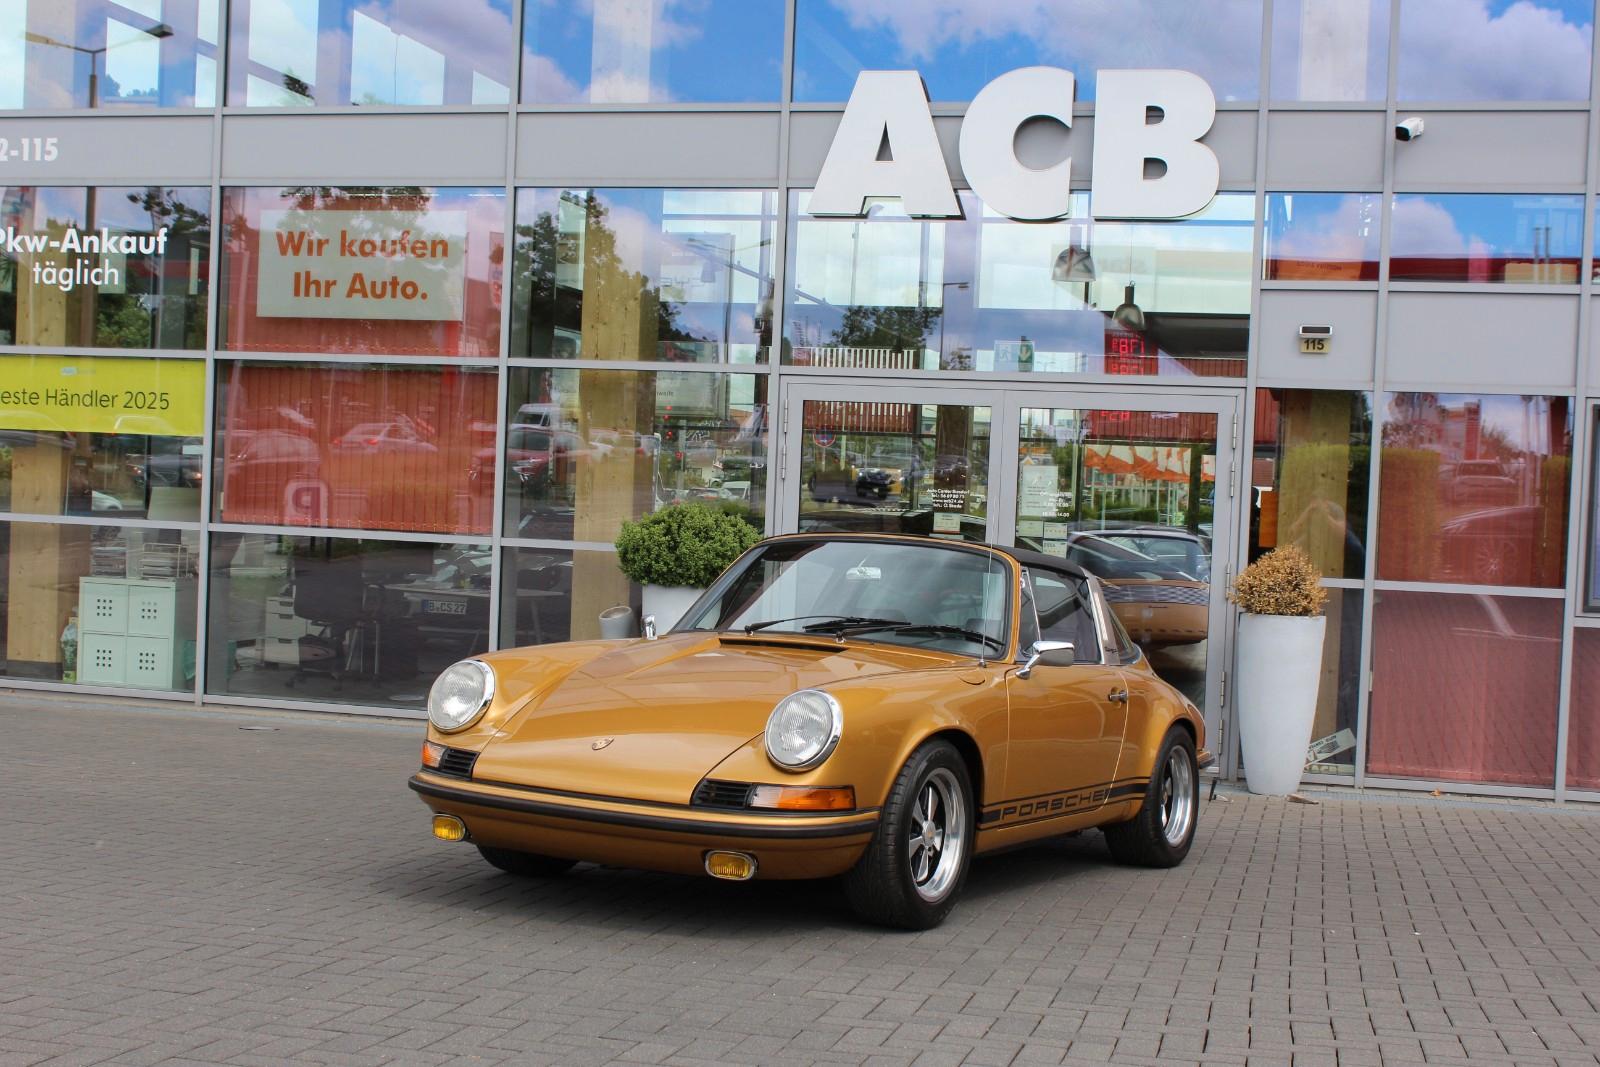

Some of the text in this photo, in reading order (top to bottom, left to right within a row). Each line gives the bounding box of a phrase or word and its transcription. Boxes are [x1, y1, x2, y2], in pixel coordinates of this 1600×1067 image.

[808, 66, 1220, 221] ACB
[275, 229, 449, 259] Wir kaufen
[33, 258, 119, 292] täglich
[293, 270, 429, 300] Ihr Auto.
[1303, 338, 1325, 351] 115
[45, 388, 119, 408] Händler
[123, 391, 170, 410] 2025
[1002, 789, 1105, 820] PORSCHE
